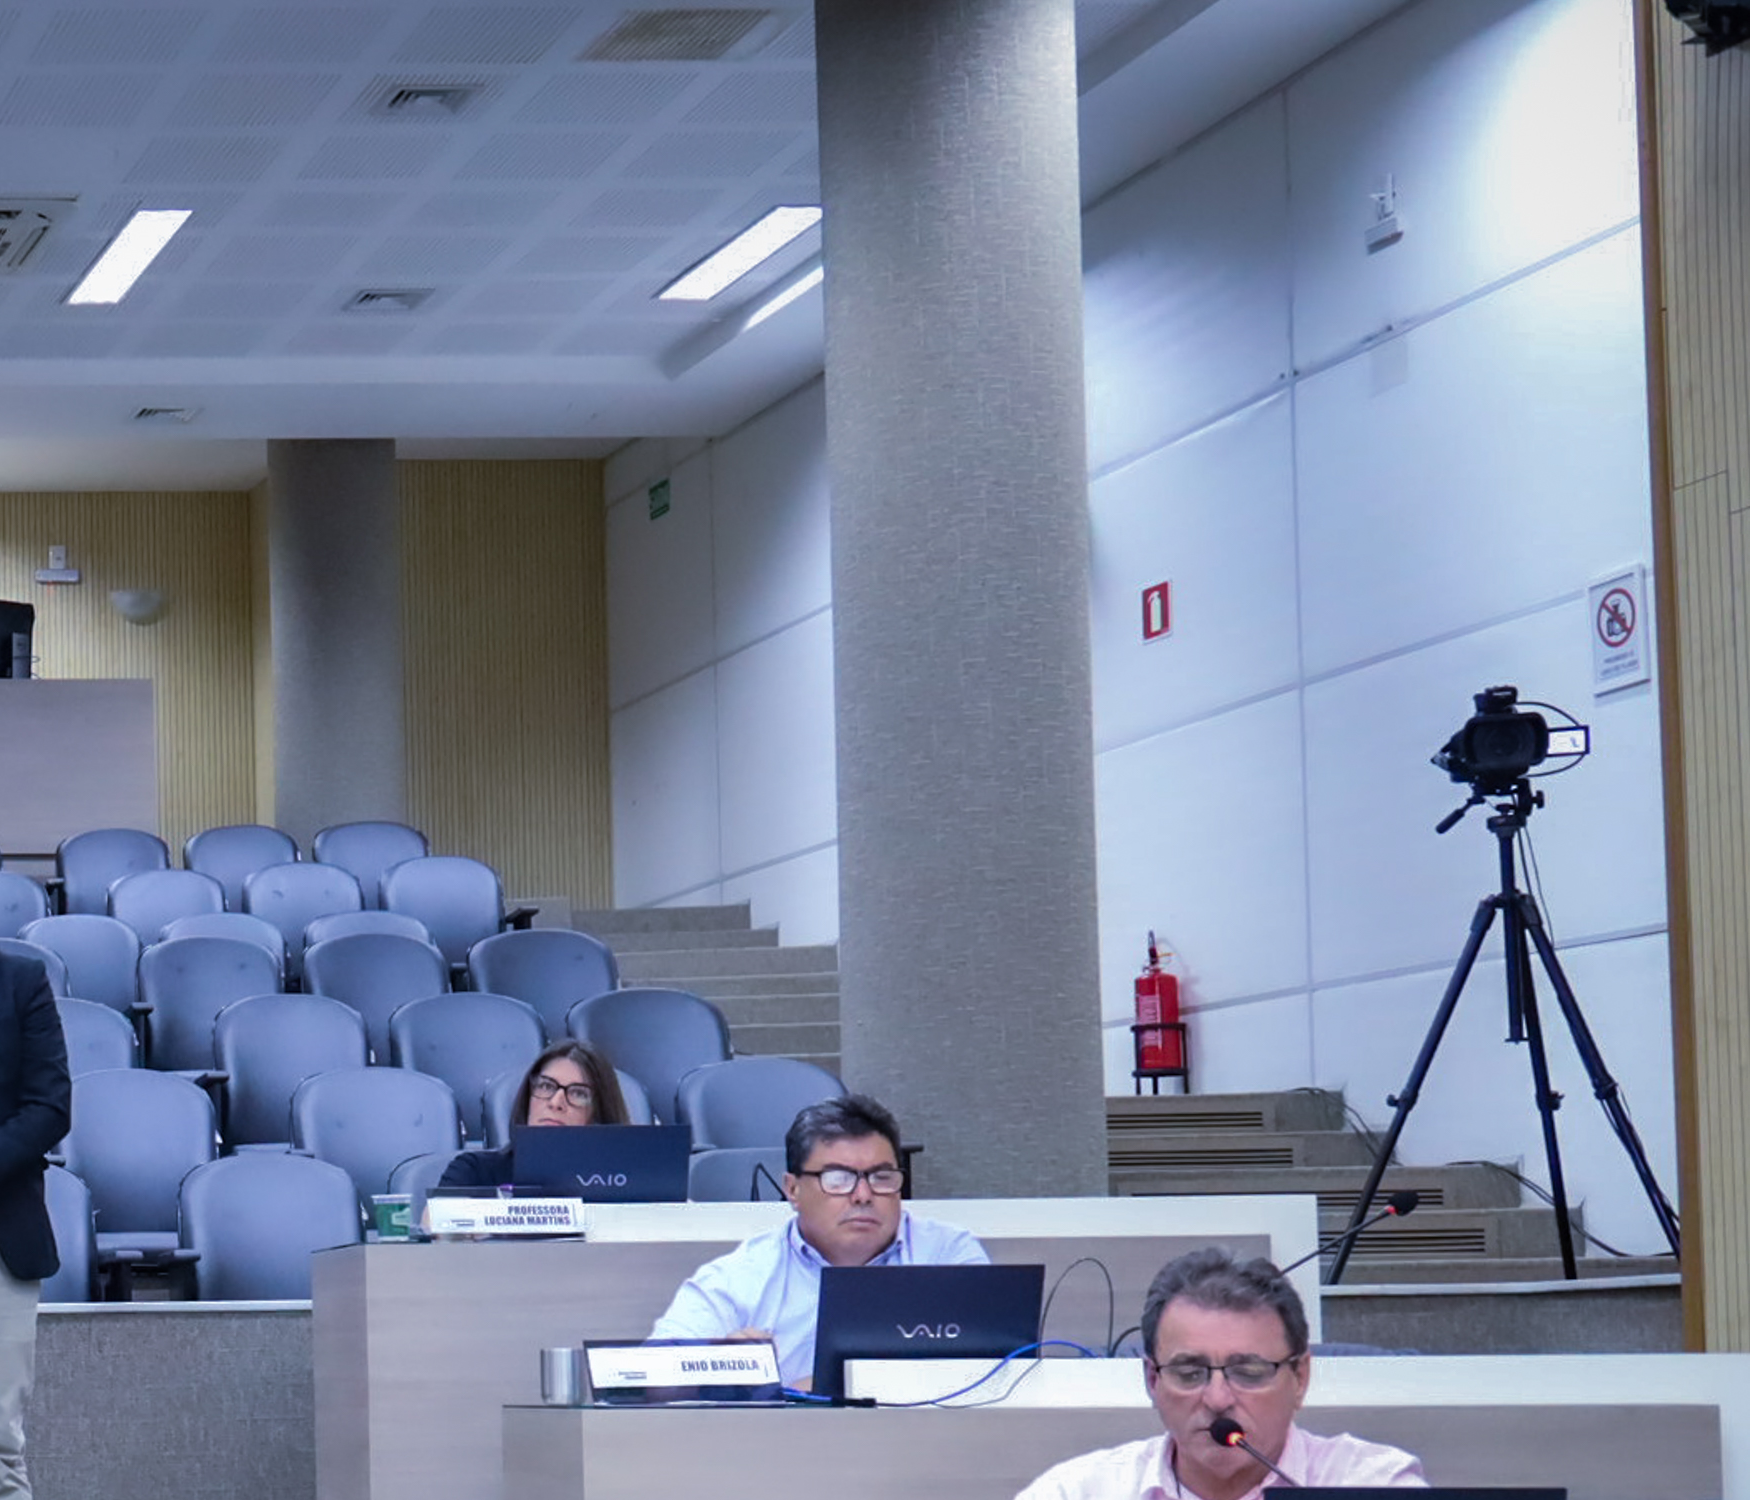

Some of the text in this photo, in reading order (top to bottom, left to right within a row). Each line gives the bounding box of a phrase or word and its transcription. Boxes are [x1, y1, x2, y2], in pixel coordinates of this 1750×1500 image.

[576, 1173, 627, 1187] VAIO
[507, 1205, 570, 1216] PROFESSORA
[484, 1215, 525, 1226] LUCIANA
[527, 1215, 571, 1226] MARTINS
[896, 1323, 960, 1339] VAIO
[681, 1359, 760, 1372] ENIO BRIZOLA
